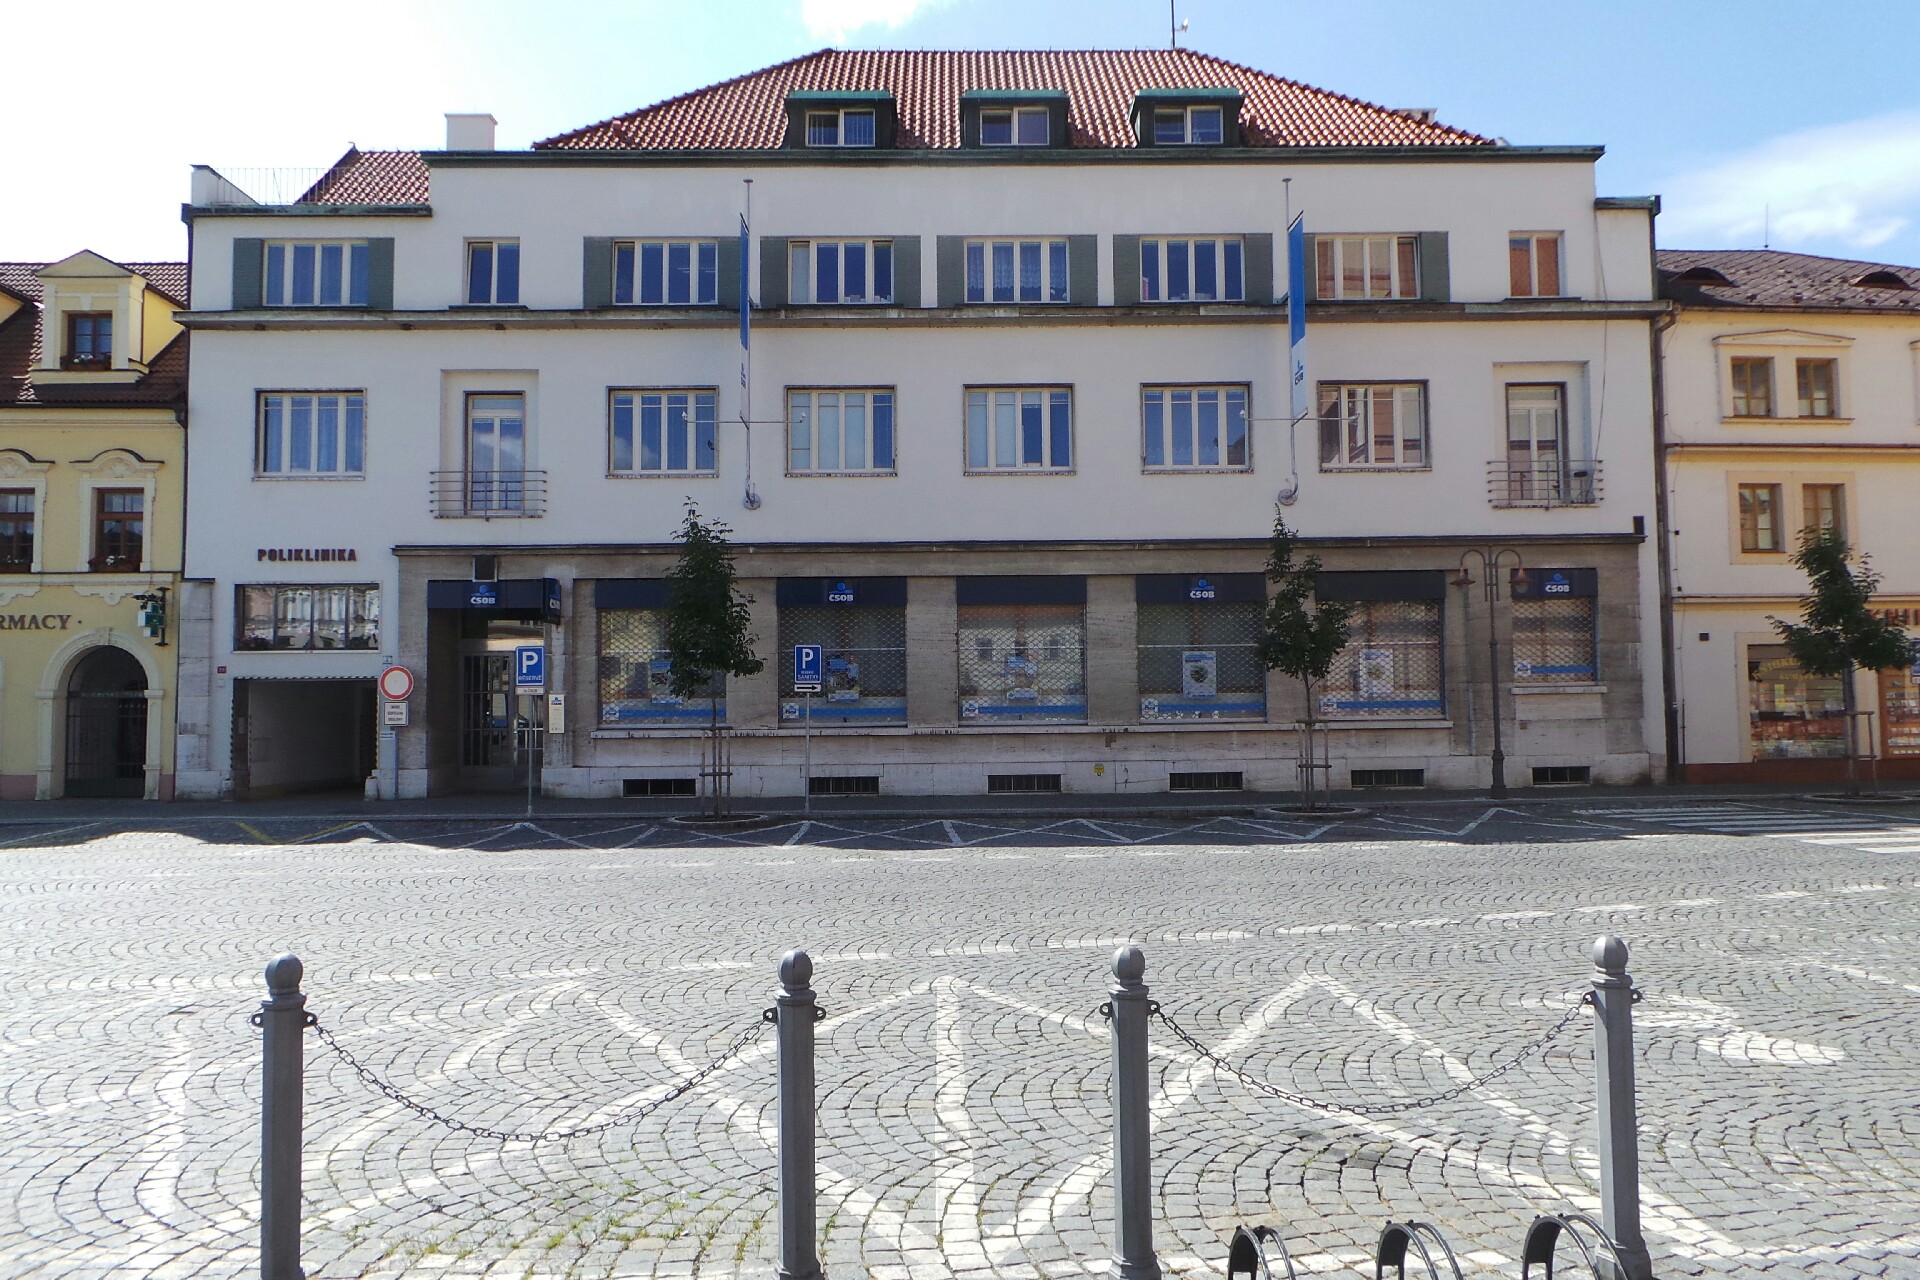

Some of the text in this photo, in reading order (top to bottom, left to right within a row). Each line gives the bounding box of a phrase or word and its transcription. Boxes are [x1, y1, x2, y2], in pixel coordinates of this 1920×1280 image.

[257, 548, 357, 562] POLIKLINIKA
[828, 594, 854, 602] ČSOB
[1189, 590, 1215, 599] ČSOB
[522, 651, 538, 673] P
[802, 648, 814, 669] P
